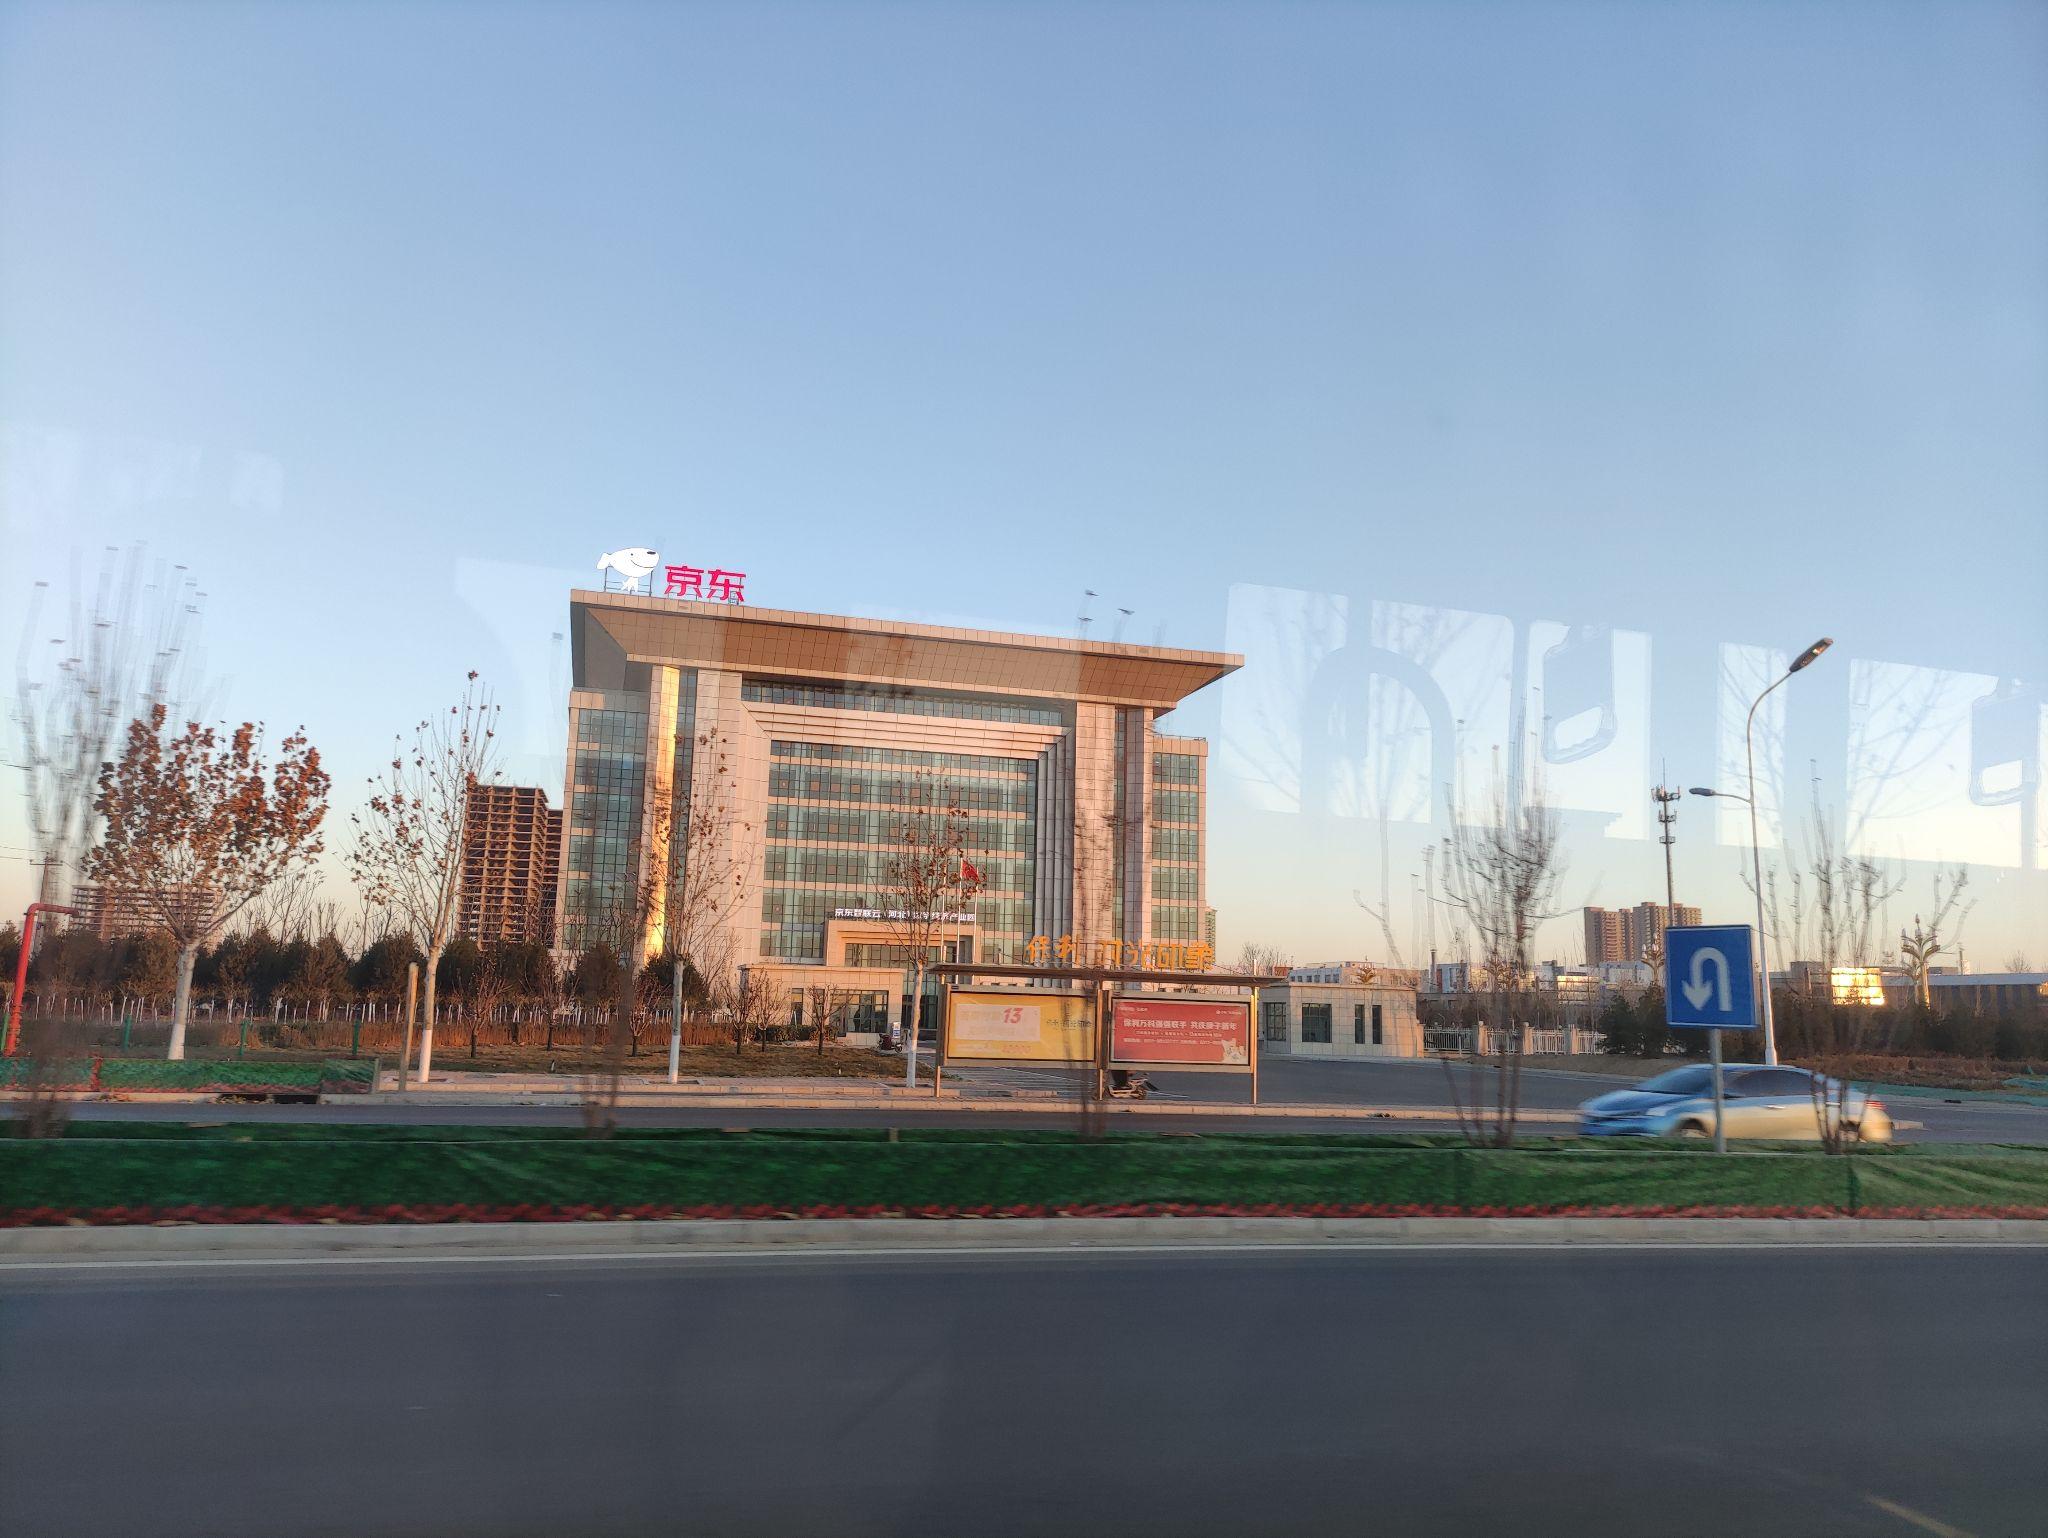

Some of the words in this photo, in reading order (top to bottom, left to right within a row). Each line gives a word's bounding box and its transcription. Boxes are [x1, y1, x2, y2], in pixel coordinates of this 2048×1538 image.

[664, 566, 746, 602] 京东
[1024, 935, 1081, 966] 保利
[1003, 1007, 1023, 1024] 13
